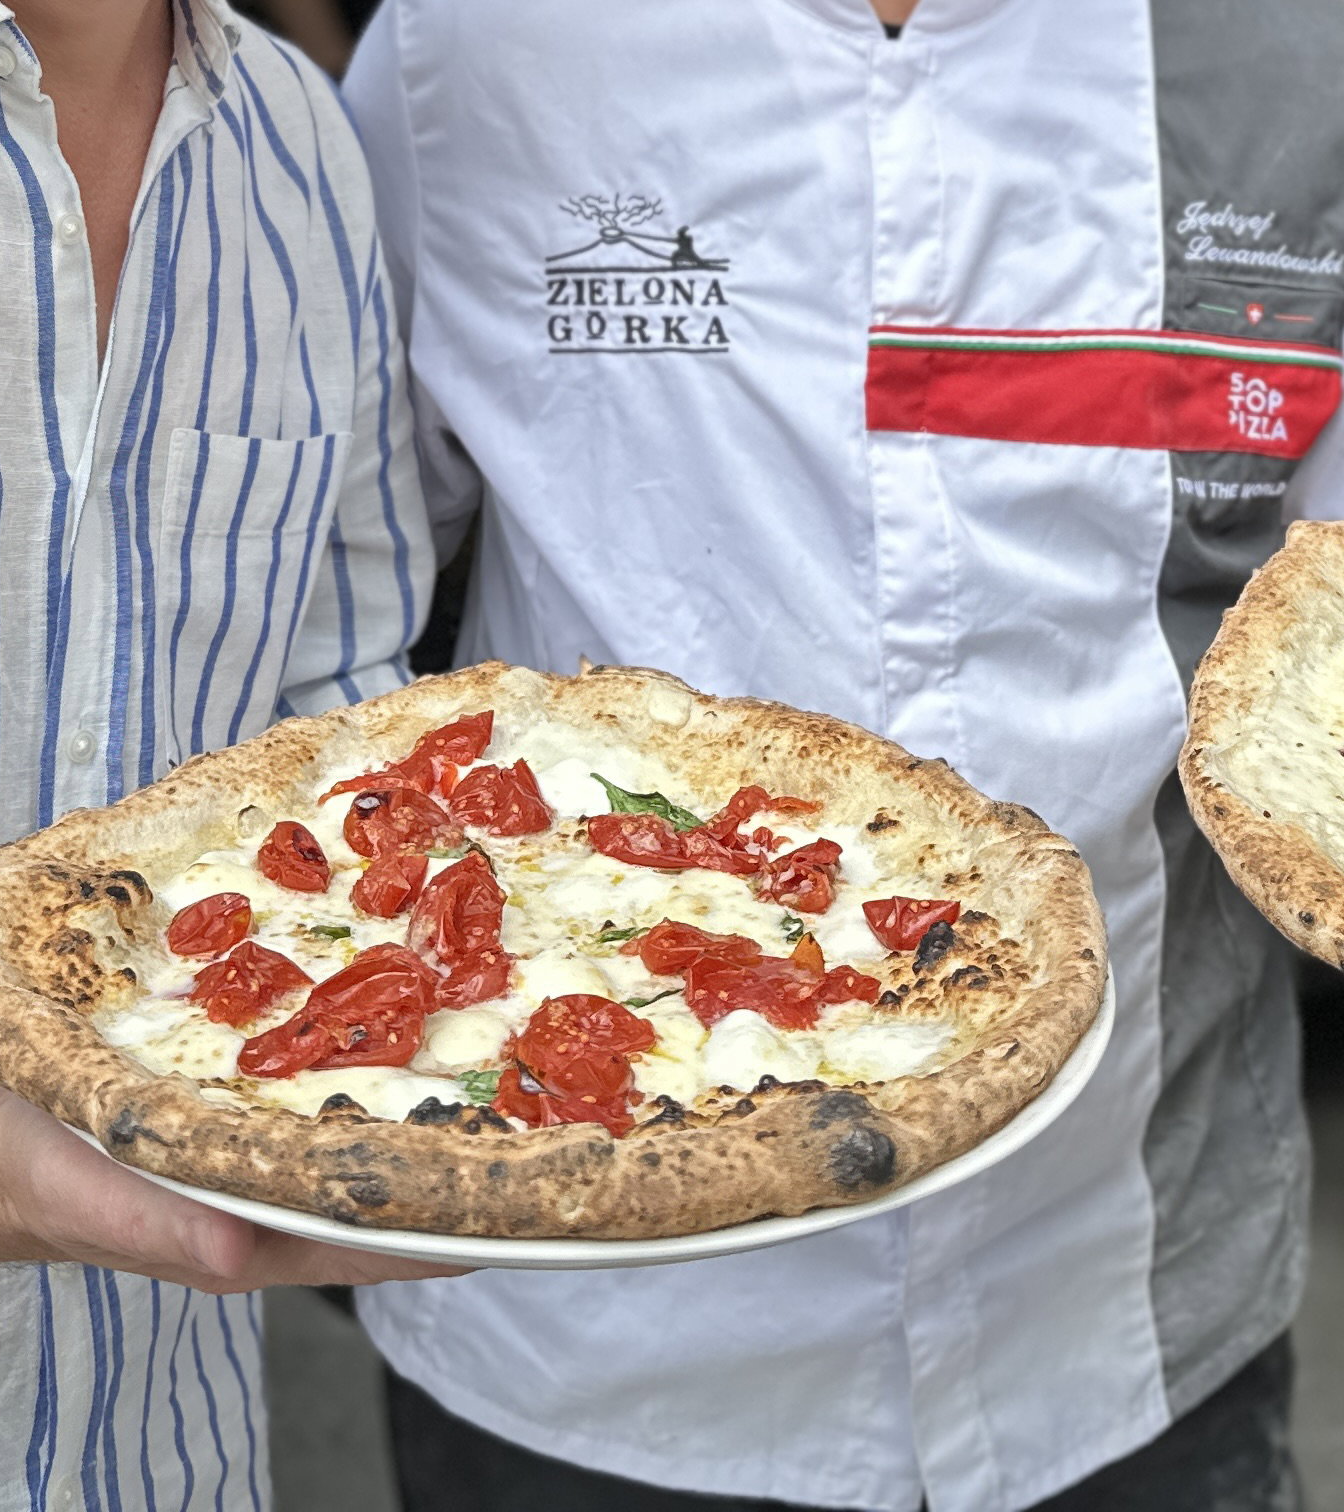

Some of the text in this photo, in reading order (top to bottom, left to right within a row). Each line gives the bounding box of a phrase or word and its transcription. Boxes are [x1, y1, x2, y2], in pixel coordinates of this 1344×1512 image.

[547, 276, 729, 306] ZIELONA
[1228, 389, 1284, 414] TOP
[1209, 482, 1239, 499] THE
[1240, 481, 1287, 499] WORLD
